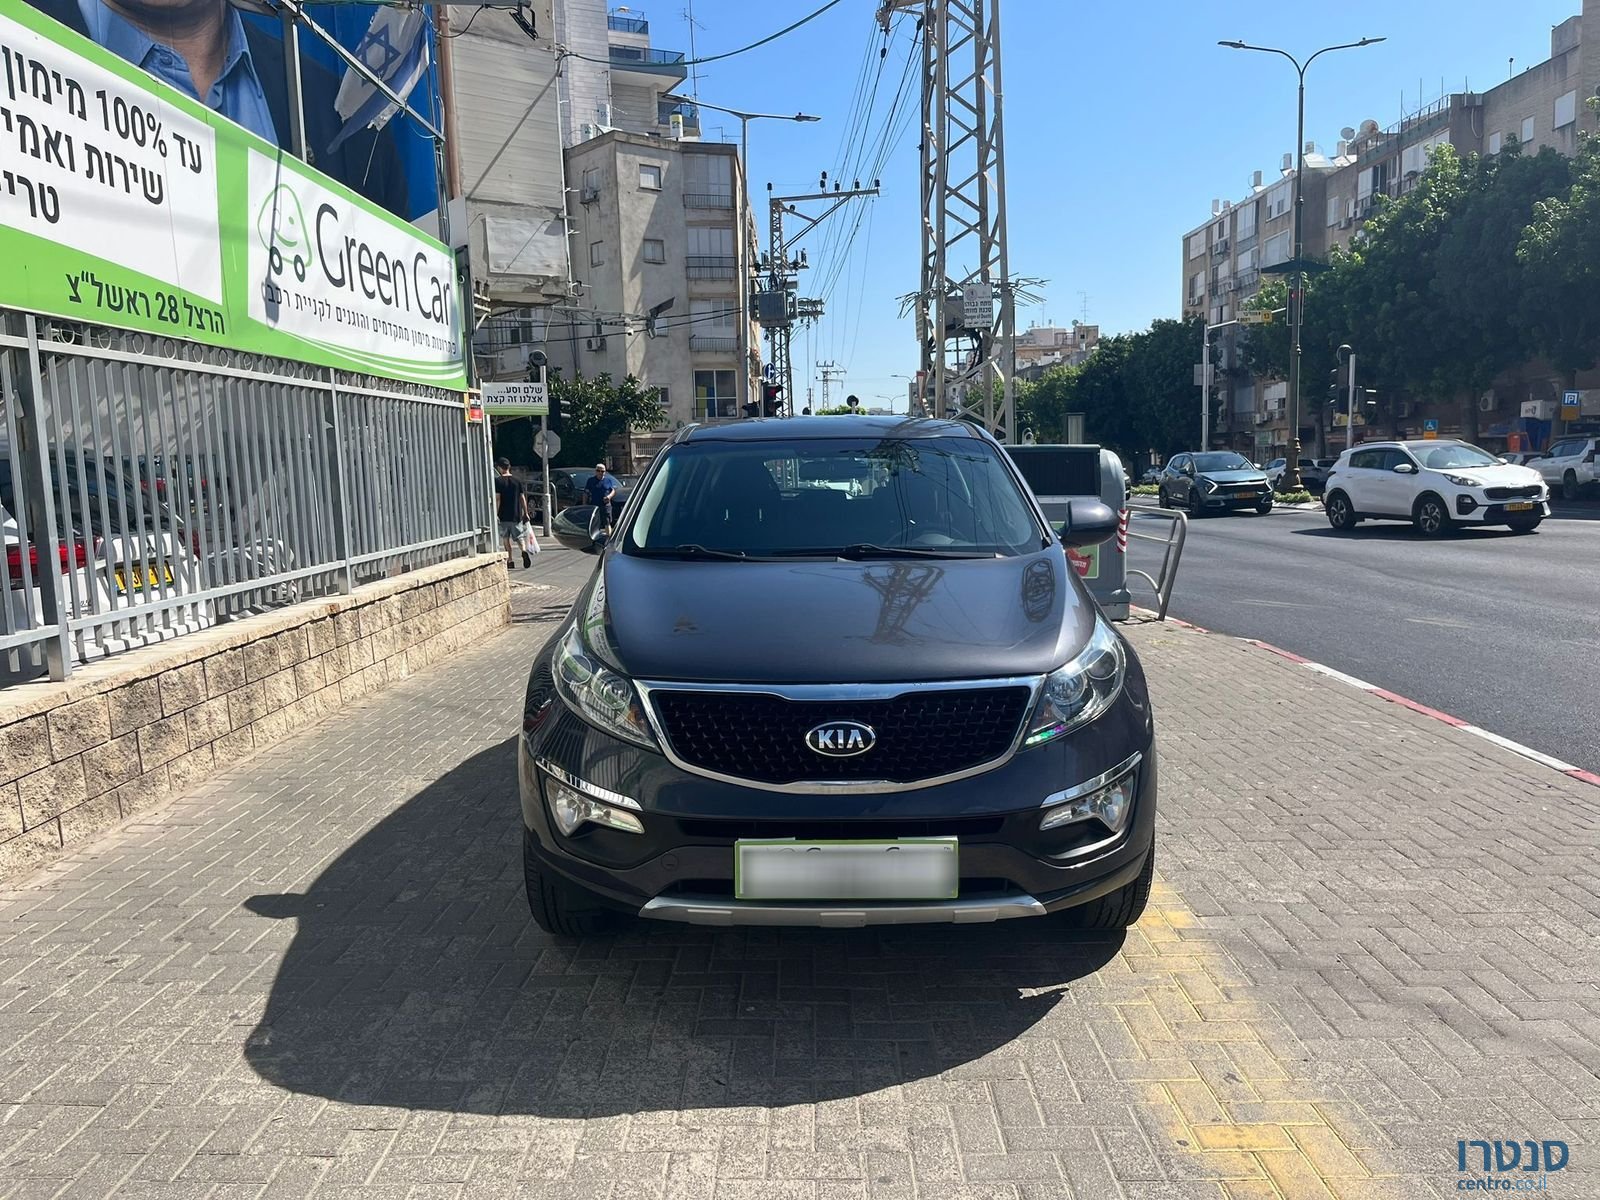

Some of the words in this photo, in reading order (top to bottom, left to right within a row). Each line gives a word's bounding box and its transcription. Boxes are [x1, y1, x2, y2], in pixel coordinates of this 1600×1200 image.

[1, 45, 87, 121] מימון
[96, 90, 167, 158] 100%
[172, 132, 202, 174] עד
[84, 142, 164, 205] שירות
[0, 170, 60, 224] טרי
[316, 203, 410, 312] Green
[413, 252, 450, 326] Car
[65, 270, 151, 318] ראשל"צ
[155, 292, 180, 324] 28
[266, 284, 290, 308] רכב
[294, 293, 331, 322] לקניית
[183, 297, 225, 335] הרצל
[335, 306, 370, 330] והוגנים
[372, 317, 409, 342] מתקדמים
[411, 329, 430, 347] מימון
[487, 395, 505, 404] קצת
[508, 395, 517, 403] זה
[520, 394, 543, 403] אצלנו
[523, 385, 542, 394] שלם
[817, 729, 865, 749] KIA
